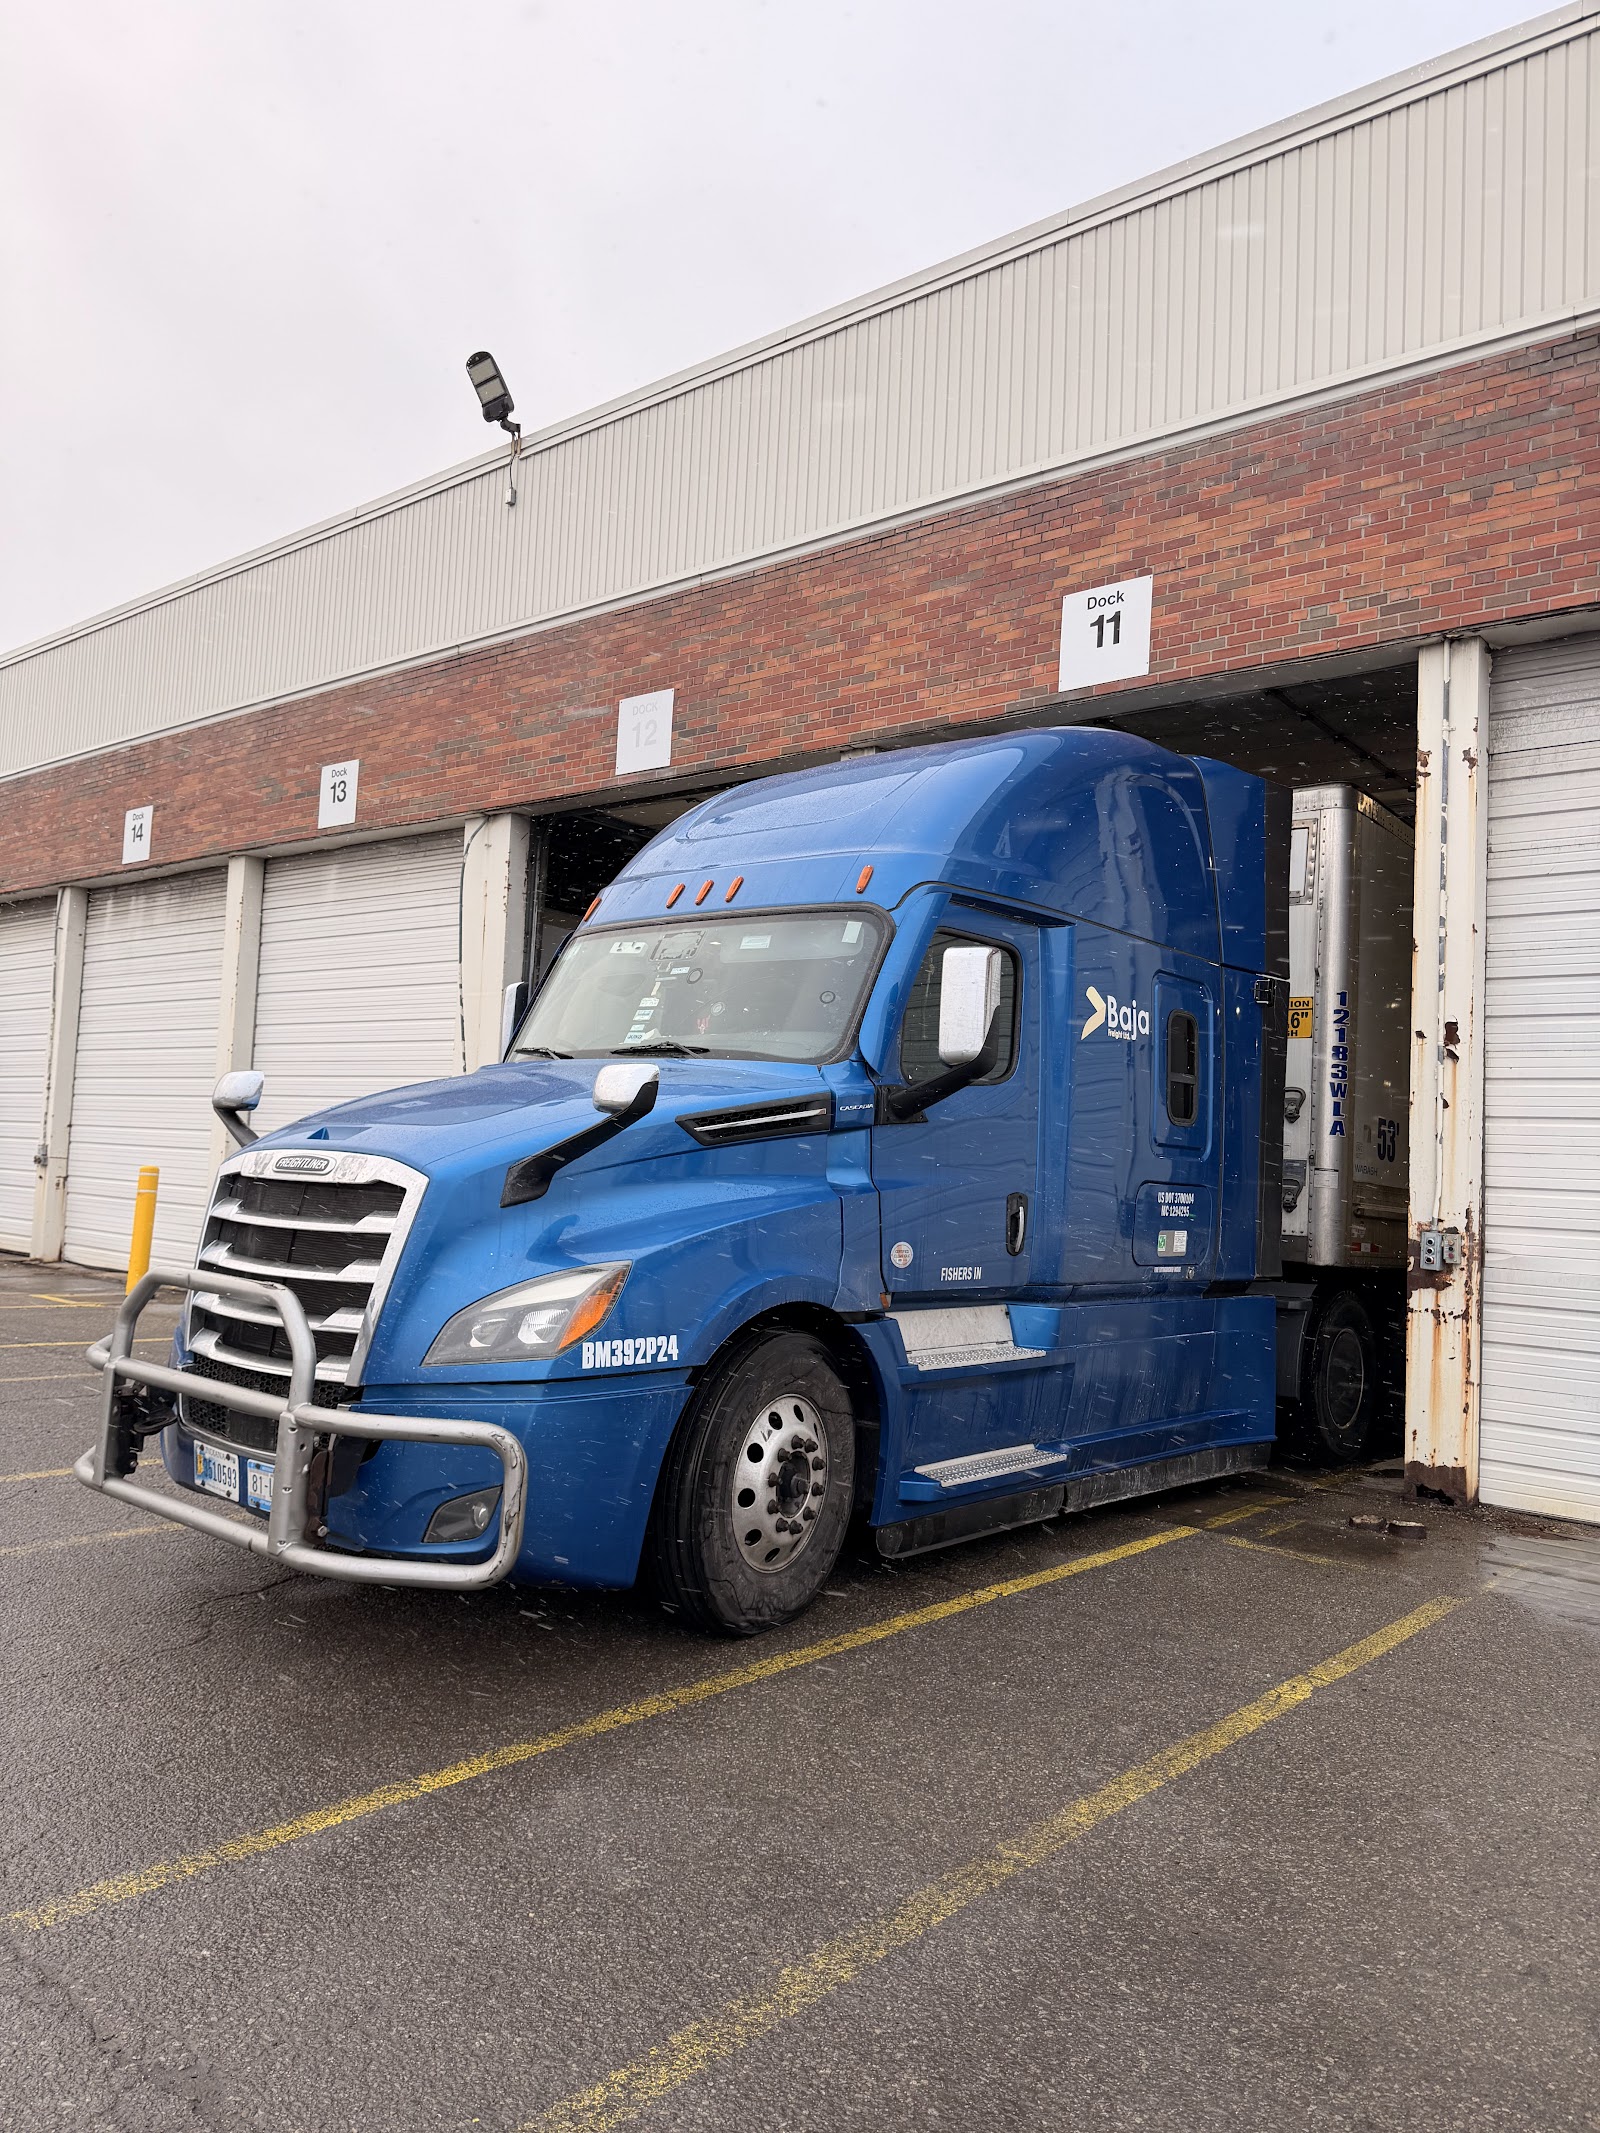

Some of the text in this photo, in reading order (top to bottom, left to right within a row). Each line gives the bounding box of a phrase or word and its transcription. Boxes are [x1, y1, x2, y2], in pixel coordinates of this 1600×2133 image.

[1087, 590, 1125, 610] Dock
[1089, 610, 1121, 649] 11
[632, 701, 658, 716] DOCK
[632, 719, 658, 748] 12
[331, 767, 348, 778] Dock
[330, 780, 347, 803] 13
[132, 812, 144, 821] Dock
[131, 823, 144, 843] 14
[1290, 1000, 1310, 1008] ION
[1107, 995, 1149, 1040] Baja
[1329, 991, 1350, 1136] 12183WLA
[839, 1103, 874, 1111] CASCADIA
[276, 1157, 329, 1170] FREIGHTLINER
[1165, 1192, 1175, 1204] DOT
[941, 1266, 982, 1281] FISHERS IN
[582, 1334, 679, 1370] BM392P24
